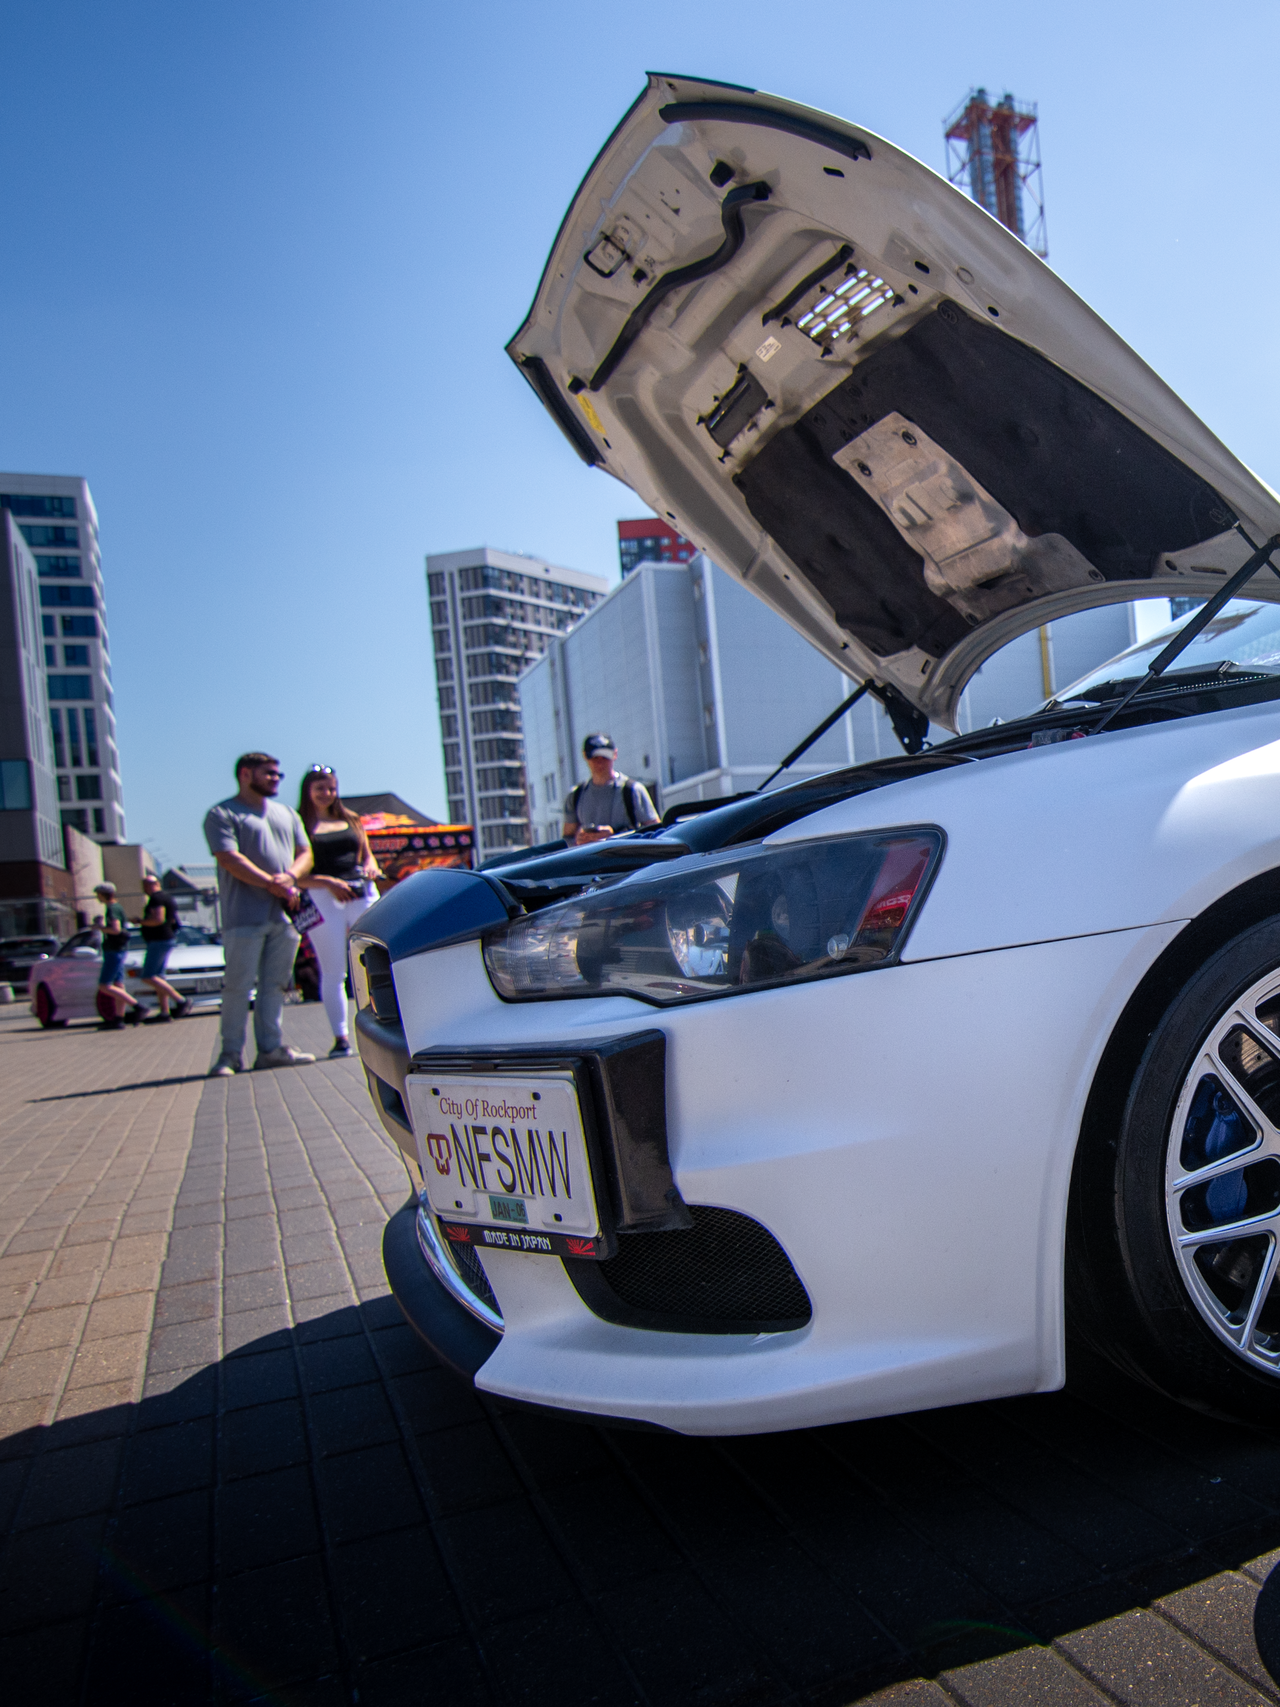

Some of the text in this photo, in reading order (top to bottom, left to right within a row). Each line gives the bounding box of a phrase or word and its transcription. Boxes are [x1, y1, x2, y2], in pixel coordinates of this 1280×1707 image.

[440, 1097, 537, 1123] City Of Rockport
[450, 1122, 572, 1199] NFSMW
[483, 1230, 552, 1250] MADE IN JAPAN
